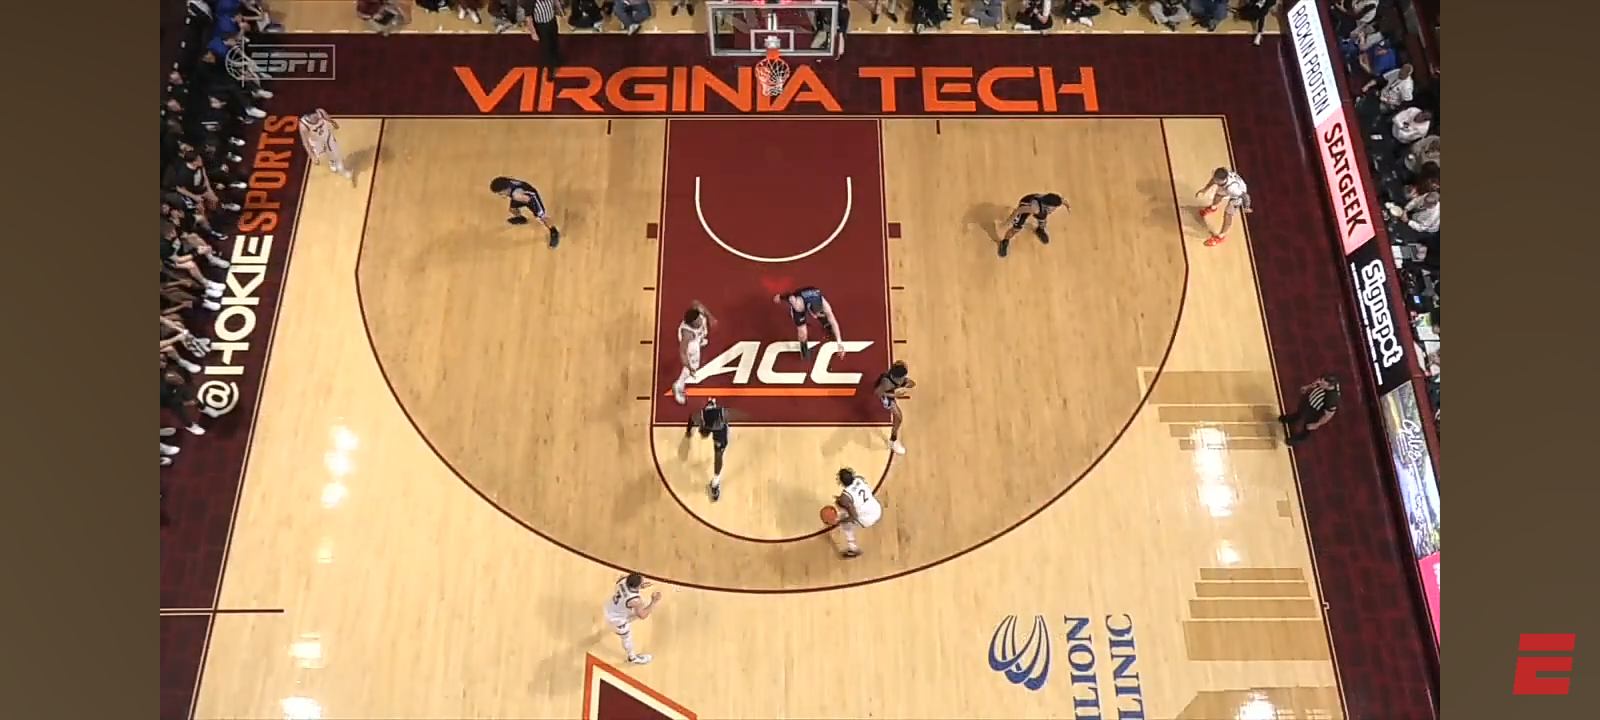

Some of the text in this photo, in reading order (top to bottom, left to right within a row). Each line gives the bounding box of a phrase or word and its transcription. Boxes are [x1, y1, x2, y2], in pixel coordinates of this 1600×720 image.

[453, 65, 1099, 113] VIRGINIA TECH
[1291, 4, 1330, 117] ROCKIN PROTEIN
[1323, 122, 1368, 239] SEATGEEK
[1361, 259, 1403, 368] Signspot
[684, 340, 875, 385] ACC
[857, 488, 870, 504] 2
